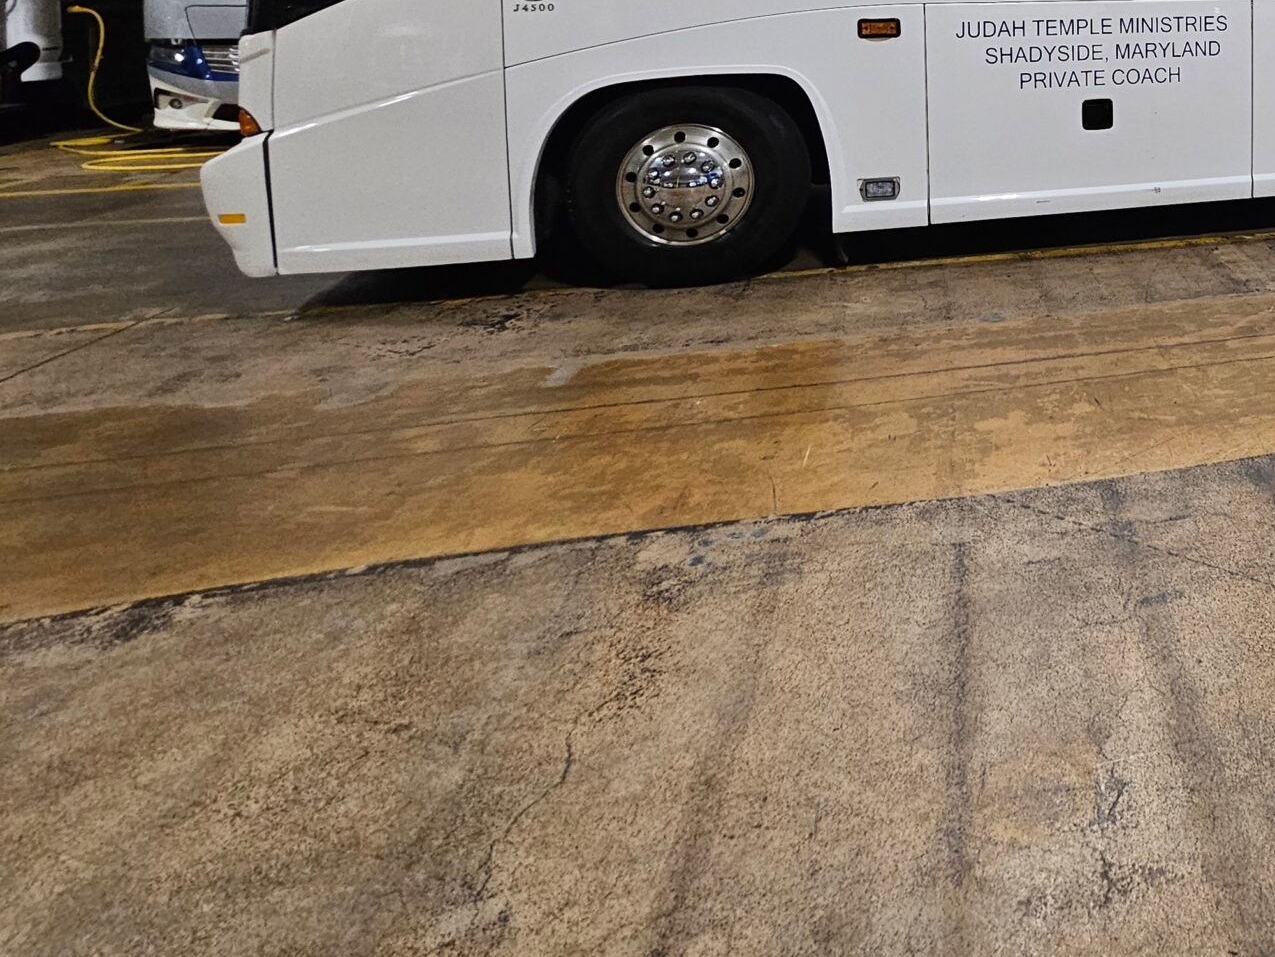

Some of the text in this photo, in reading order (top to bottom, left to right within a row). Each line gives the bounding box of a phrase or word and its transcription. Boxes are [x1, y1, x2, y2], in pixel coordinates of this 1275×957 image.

[512, 3, 555, 12] J4500
[955, 15, 1228, 39] JUDAH TEMPLE MINISTRIES
[985, 40, 1221, 64] SHADYSIDE, MARYLAND
[1020, 66, 1181, 89] PRIVATE COACH
